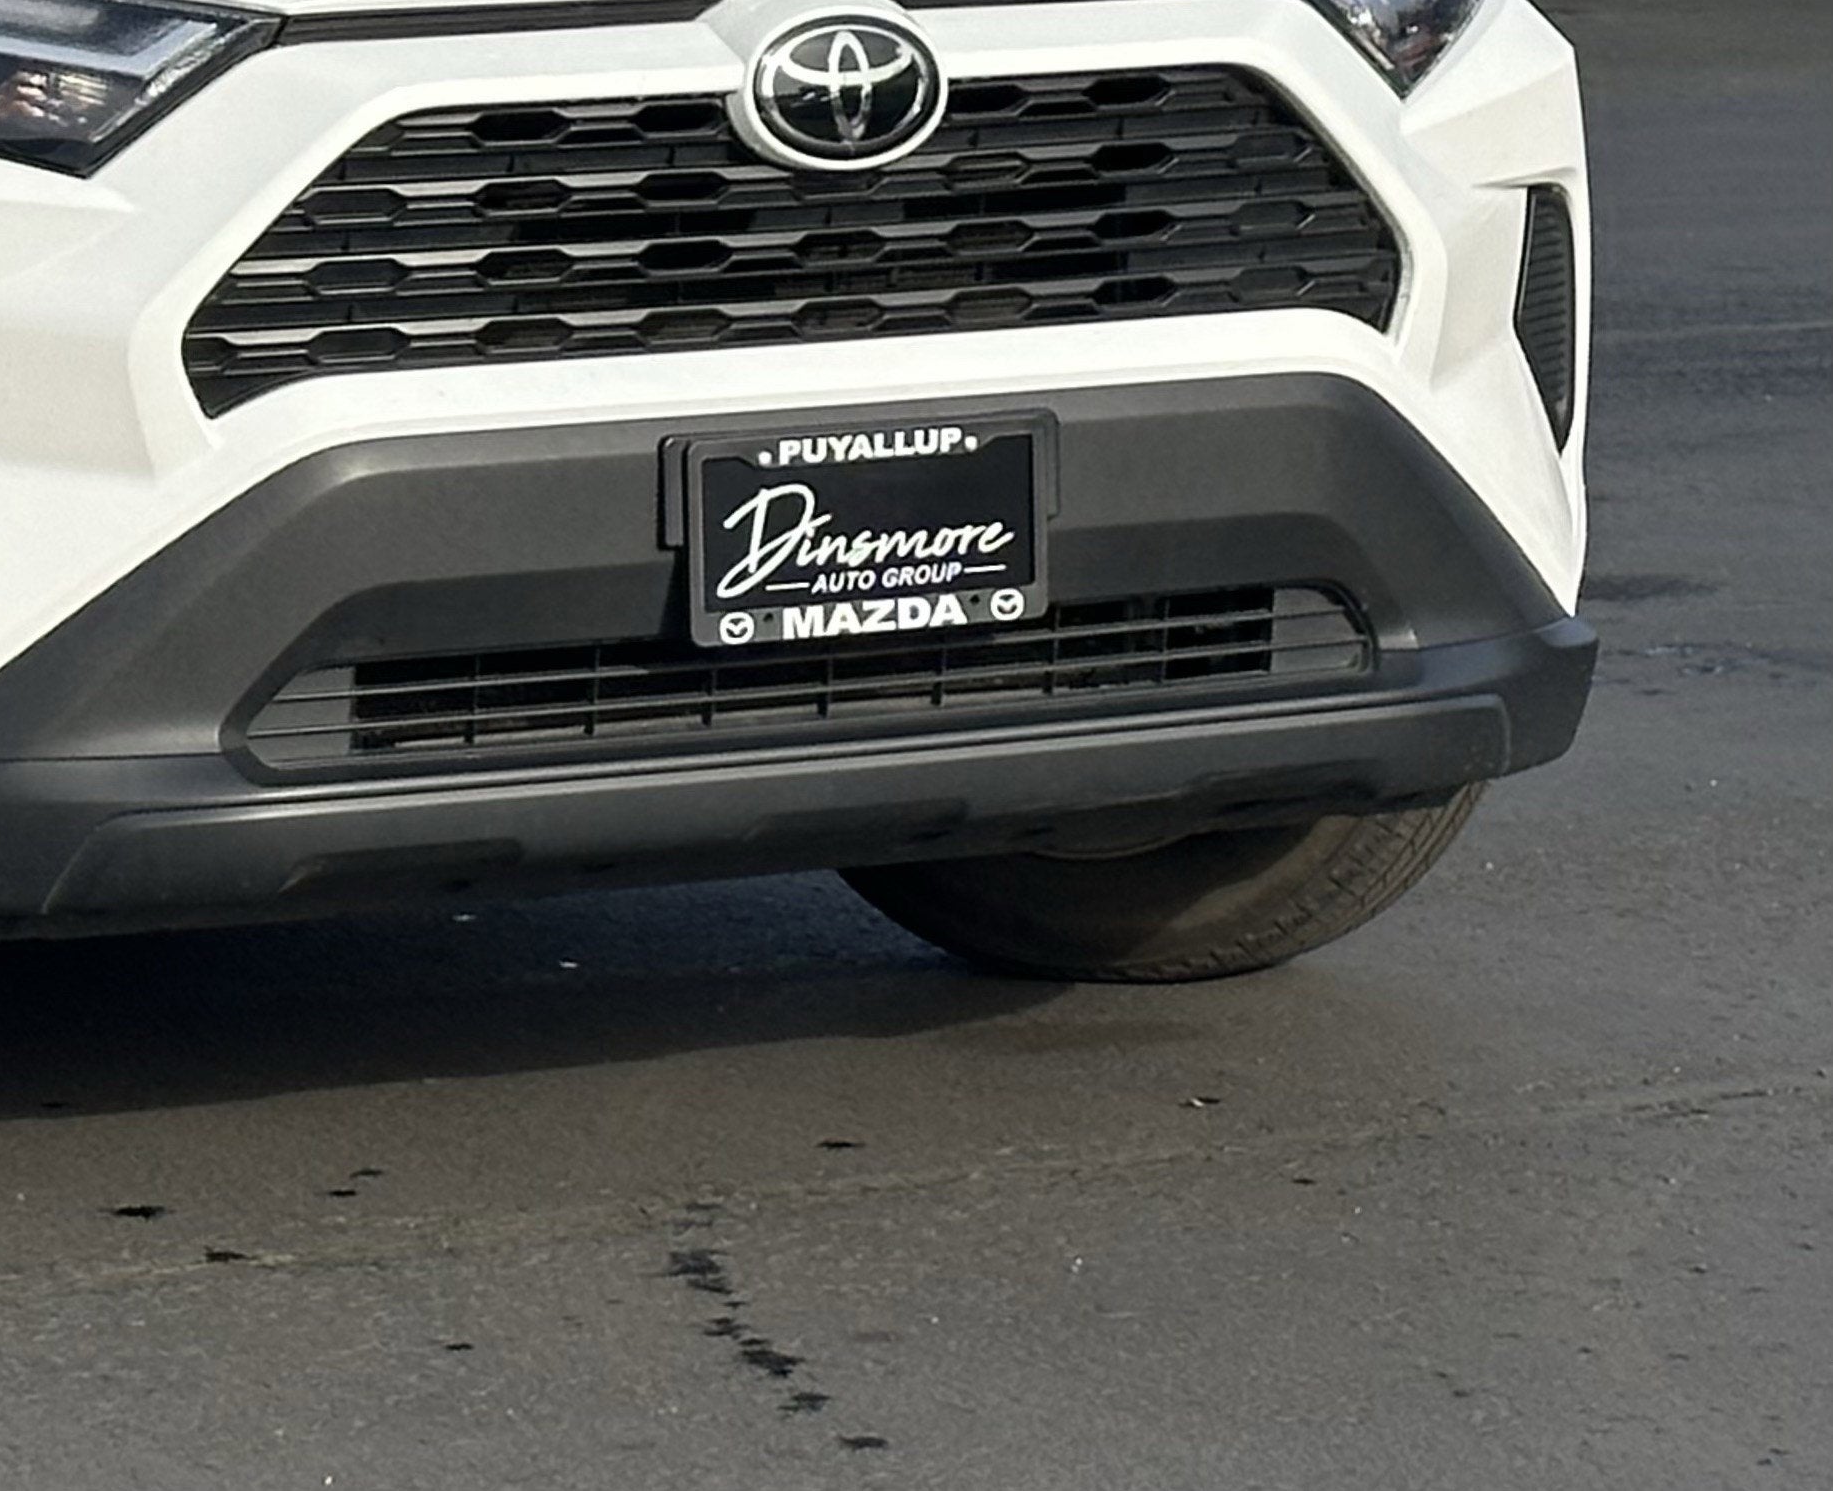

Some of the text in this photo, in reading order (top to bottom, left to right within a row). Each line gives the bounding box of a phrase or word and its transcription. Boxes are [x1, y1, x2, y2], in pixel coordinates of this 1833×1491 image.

[779, 428, 962, 465] PUYALLUP
[717, 484, 1014, 598] Dinsmore
[811, 561, 963, 594] AUTO GROUP
[782, 594, 968, 640] MAZDA
